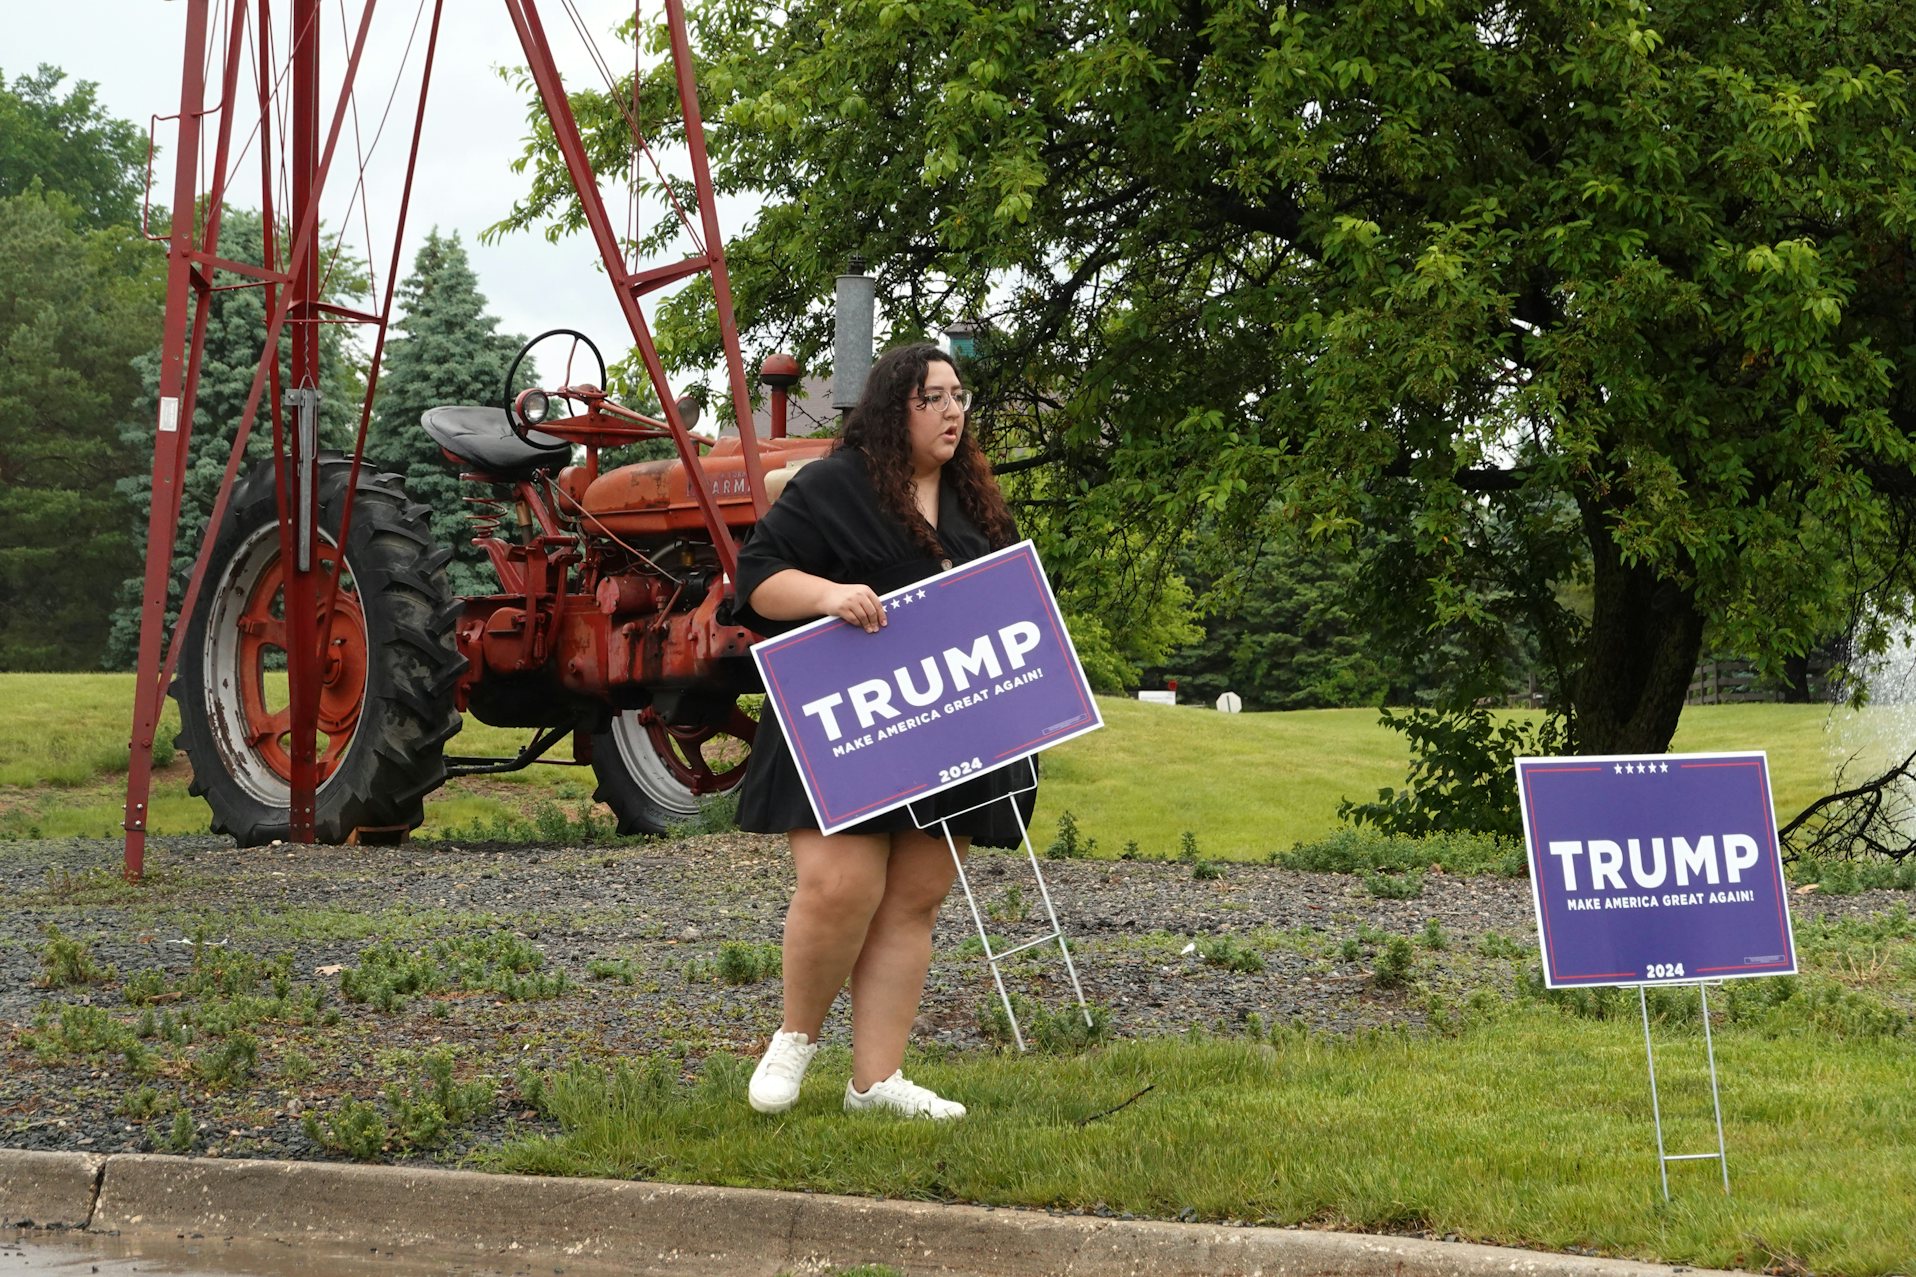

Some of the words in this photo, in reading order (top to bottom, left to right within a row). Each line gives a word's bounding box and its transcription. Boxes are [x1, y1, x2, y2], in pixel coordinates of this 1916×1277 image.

[801, 620, 1042, 742] TRUMP
[832, 734, 875, 758] MAKE
[877, 709, 942, 741] AMERICA
[943, 688, 989, 715] GREAT
[994, 667, 1044, 696] AGAIN!
[938, 756, 983, 784] 2024
[1548, 833, 1759, 892] TRUMP
[1567, 898, 1602, 911] MAKE
[1604, 895, 1660, 909] AMERICA
[1662, 892, 1705, 907] GREAT
[1708, 890, 1755, 904] AGAIN!
[1646, 962, 1685, 979] 2024
